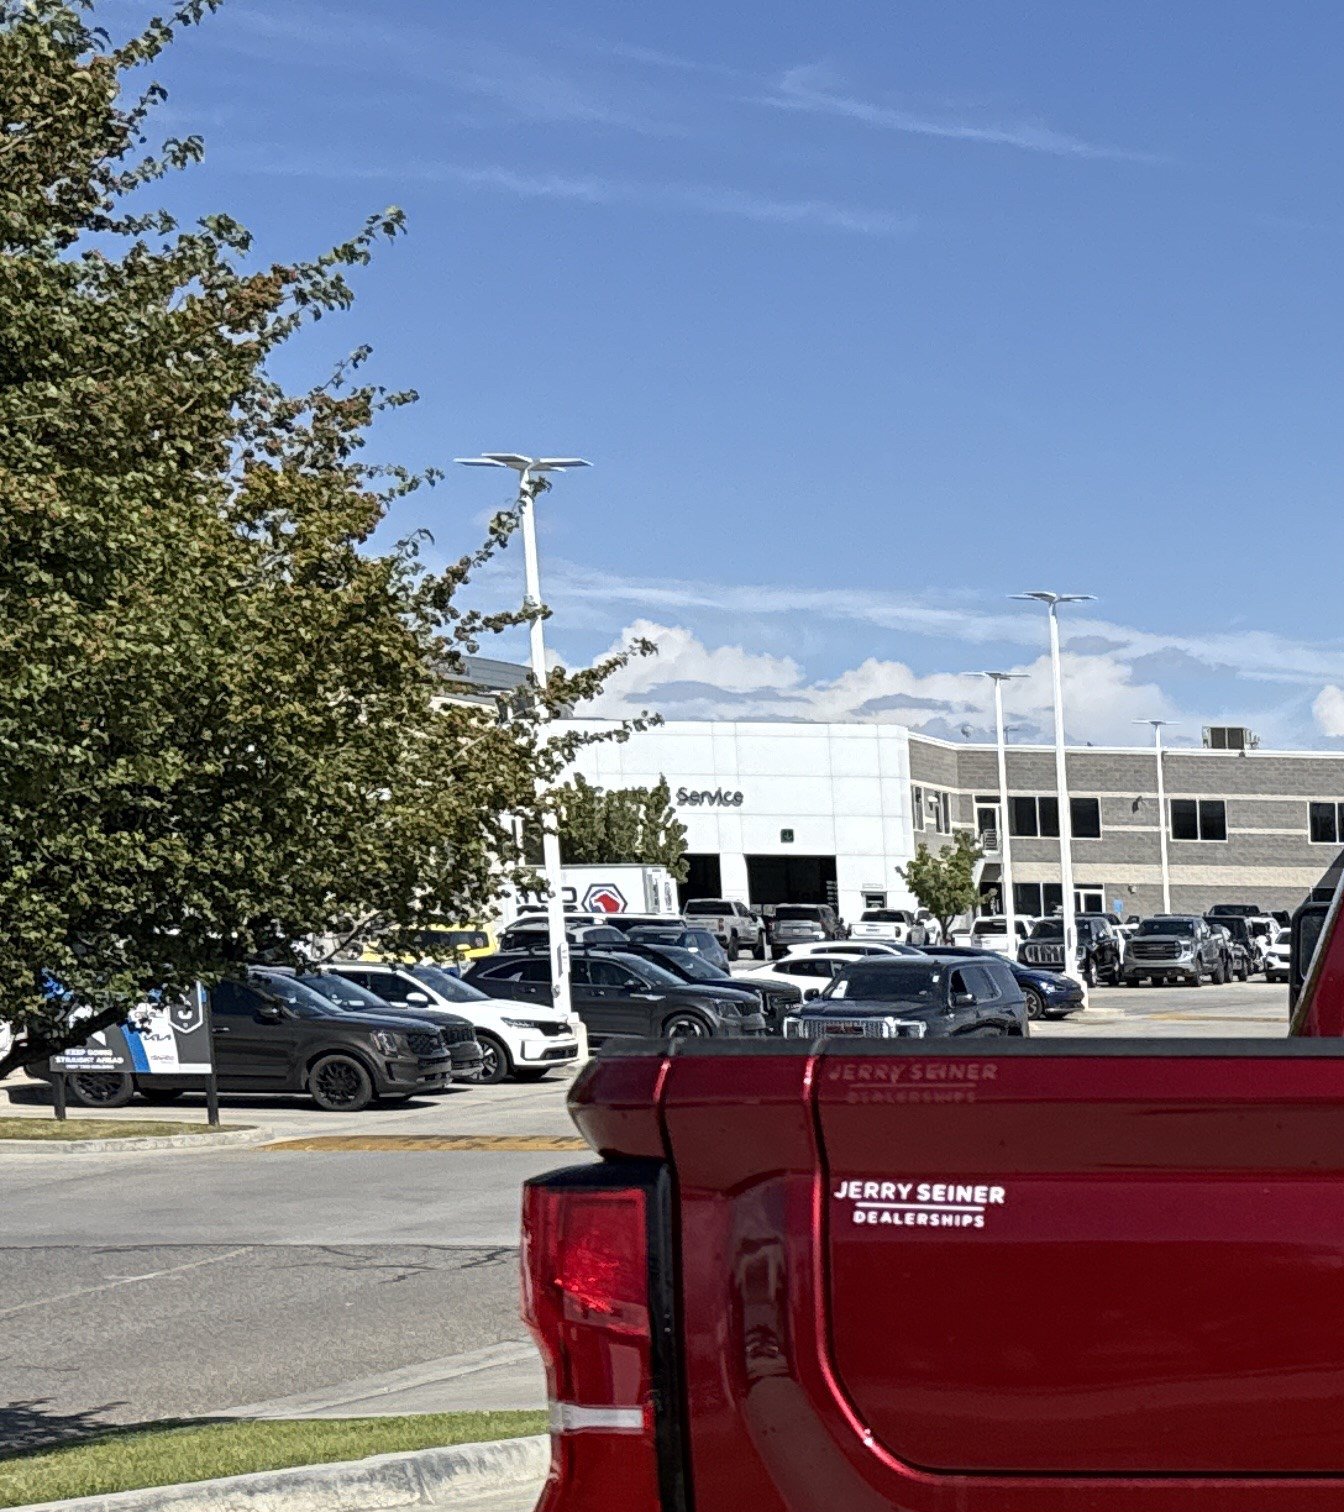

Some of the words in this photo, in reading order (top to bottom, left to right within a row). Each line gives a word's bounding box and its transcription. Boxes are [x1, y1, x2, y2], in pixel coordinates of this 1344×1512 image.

[676, 787, 744, 806] Service
[834, 1181, 914, 1200] JERRY
[917, 1183, 1005, 1204] SEINER
[853, 1211, 985, 1228] DEALERSHIPS
